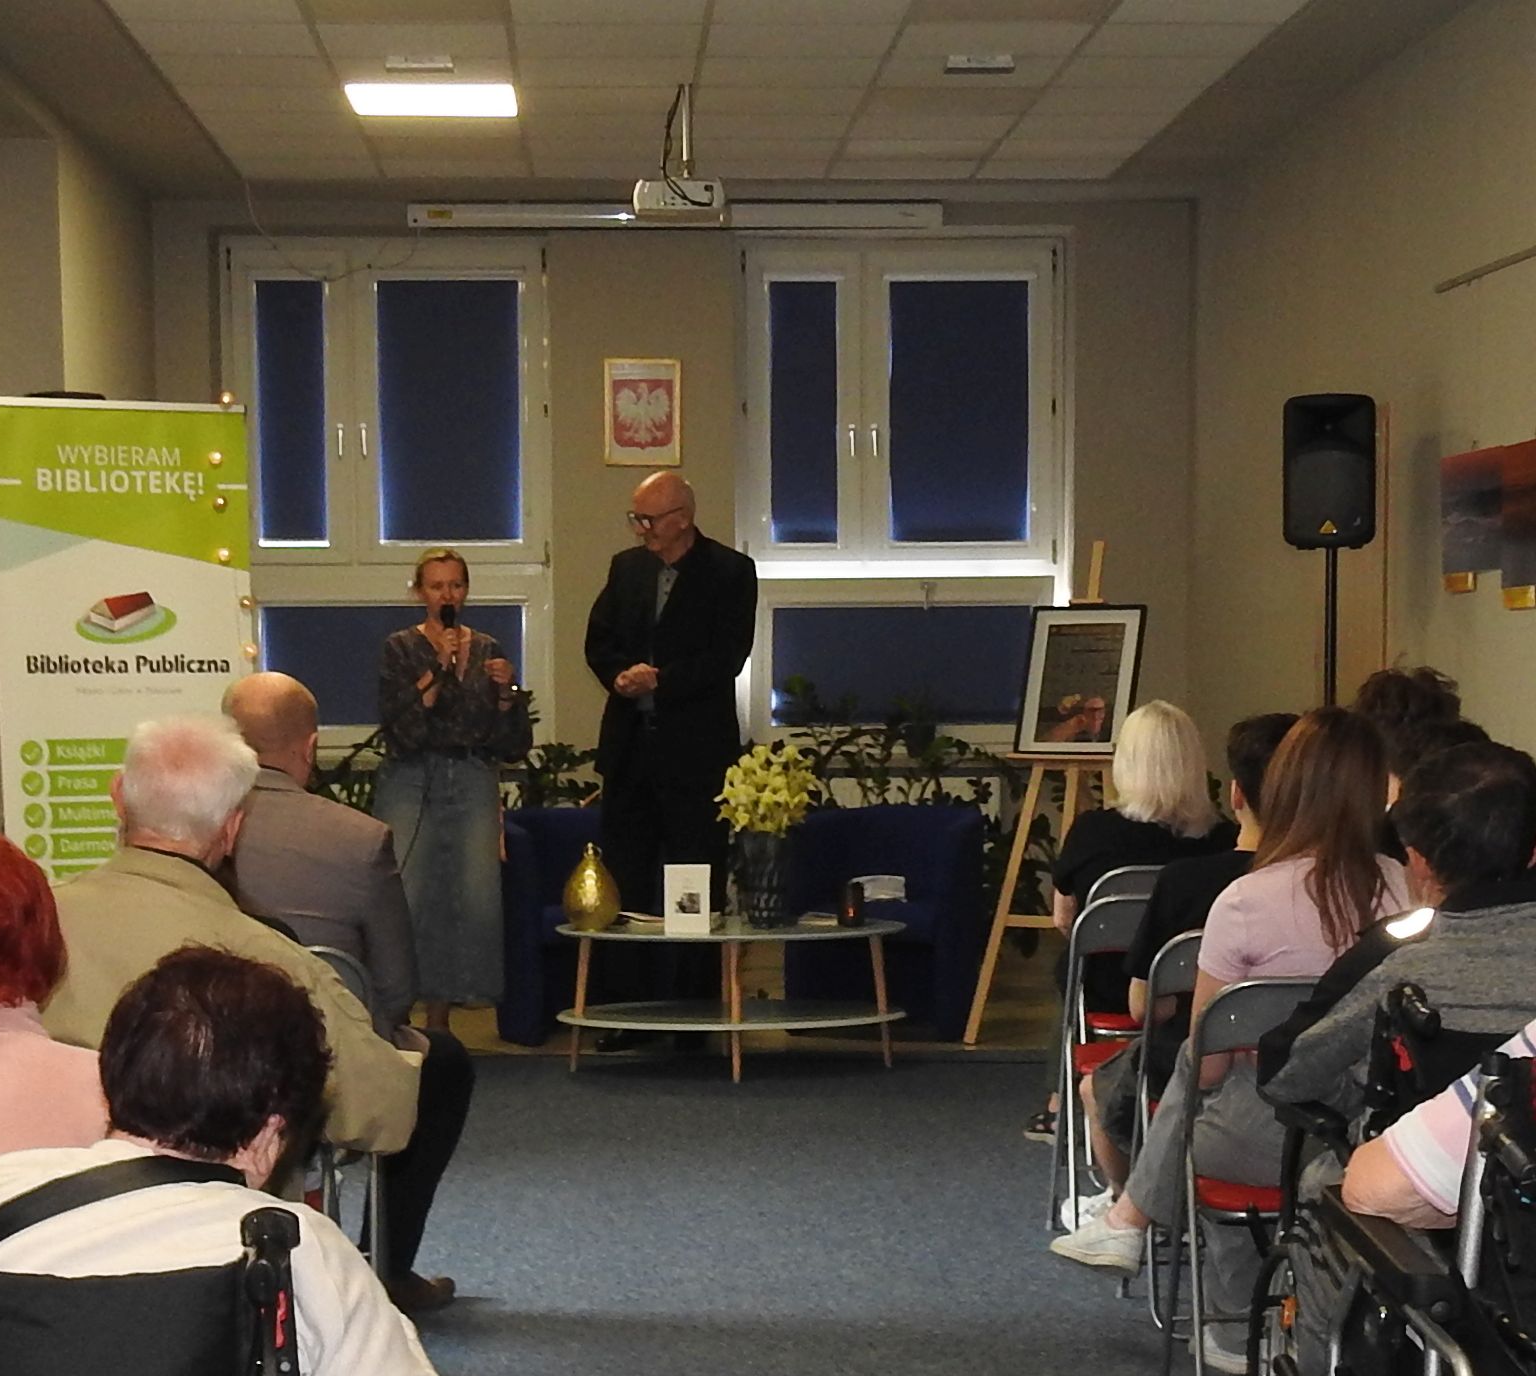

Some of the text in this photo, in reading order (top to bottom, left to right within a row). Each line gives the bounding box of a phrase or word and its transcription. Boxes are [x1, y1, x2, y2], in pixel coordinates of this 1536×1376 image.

[57, 445, 181, 466] WYBIERAM
[36, 468, 205, 501] BIBLIOTEKĘ!
[26, 654, 230, 674] Biblioteka Publiczna
[58, 776, 98, 790] Prasa
